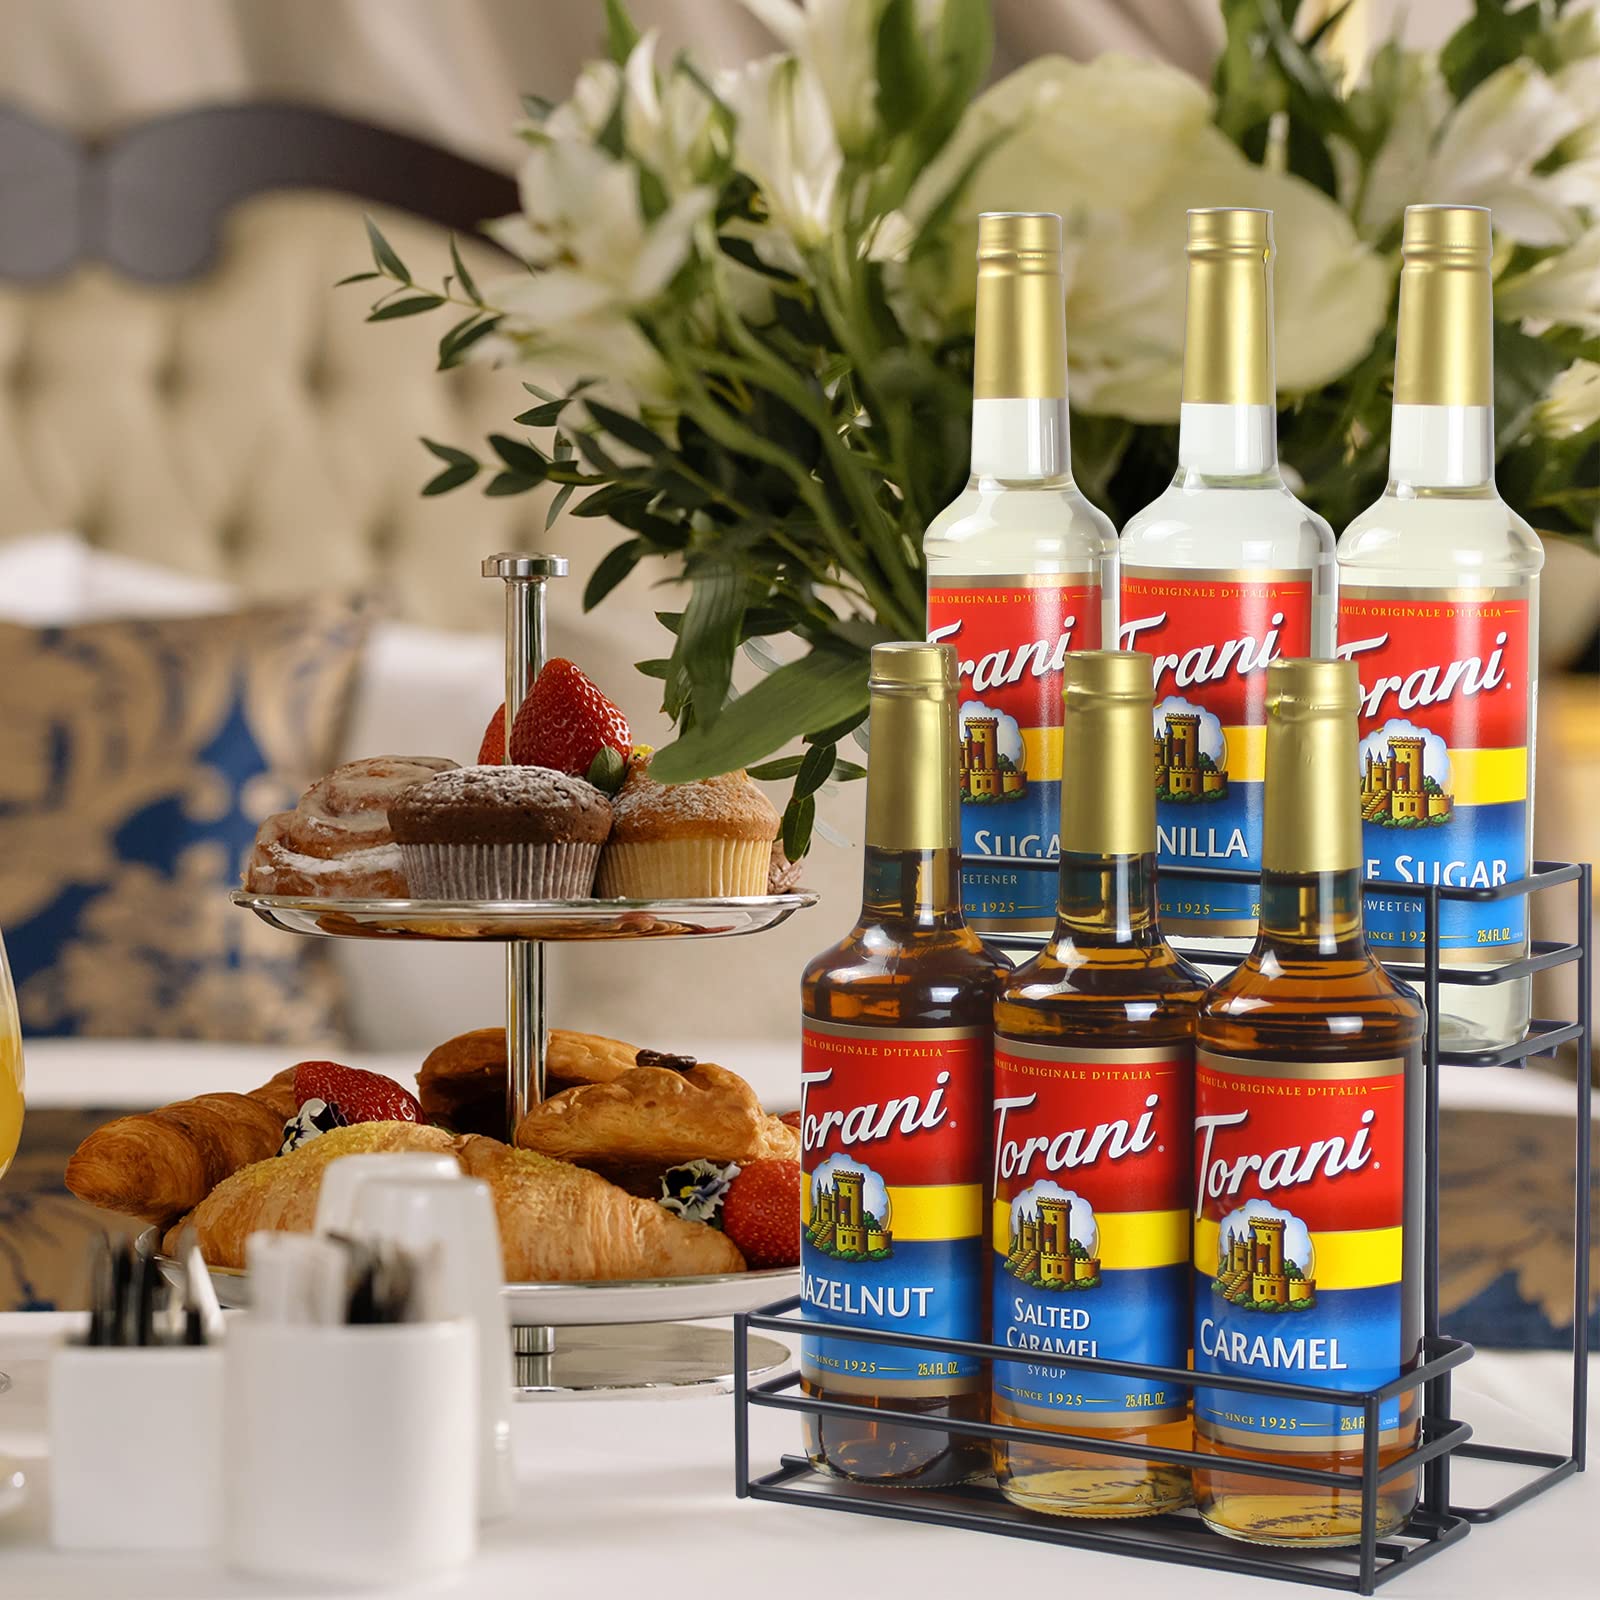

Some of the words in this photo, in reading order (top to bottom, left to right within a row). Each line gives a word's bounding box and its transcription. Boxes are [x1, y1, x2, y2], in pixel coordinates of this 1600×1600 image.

[947, 594, 1008, 604] ORIGINALE
[1151, 587, 1215, 598] ORIGINALE
[1221, 589, 1277, 598] D'ITALIA
[1371, 607, 1440, 618] ORIGINALE
[1447, 608, 1501, 618] D'ITALIA
[1120, 611, 1284, 688] Trani
[974, 830, 1061, 858] SUGA
[1156, 825, 1248, 858] NILLA
[962, 874, 1018, 885] EETENER
[1395, 855, 1507, 888] SUGAR
[981, 902, 1015, 913] 1925
[1177, 903, 1210, 914] 1925
[1364, 900, 1422, 913] WEETEN
[1368, 931, 1394, 940] INCE
[1401, 931, 1426, 942] 192
[820, 1041, 878, 1056] ORIGINALE
[883, 1048, 943, 1057] D'ITALIA
[1021, 1065, 1086, 1080] ORIGINALE
[1092, 1071, 1151, 1080] D'ITALIA
[1232, 1082, 1301, 1096] ORIGINALE
[1307, 1086, 1367, 1096] D'ITALIA
[801, 1067, 950, 1151] Torani
[993, 1092, 1159, 1199] Torani
[1195, 1109, 1375, 1220] Torani
[1014, 1297, 1090, 1330] SALTED
[1007, 1326, 1099, 1358] CARAMEL
[1200, 1318, 1348, 1370] CARAMEL
[816, 1355, 840, 1368] SINCE
[843, 1359, 877, 1373] 1925
[918, 1362, 935, 1376] 25.4
[1027, 1365, 1066, 1379] SYRUP
[1016, 1388, 1043, 1401] SINCE
[1048, 1392, 1083, 1406] 1925
[1225, 1412, 1254, 1425] SINCE
[1260, 1416, 1297, 1430] 1925
[1341, 1417, 1357, 1431] 25.4
